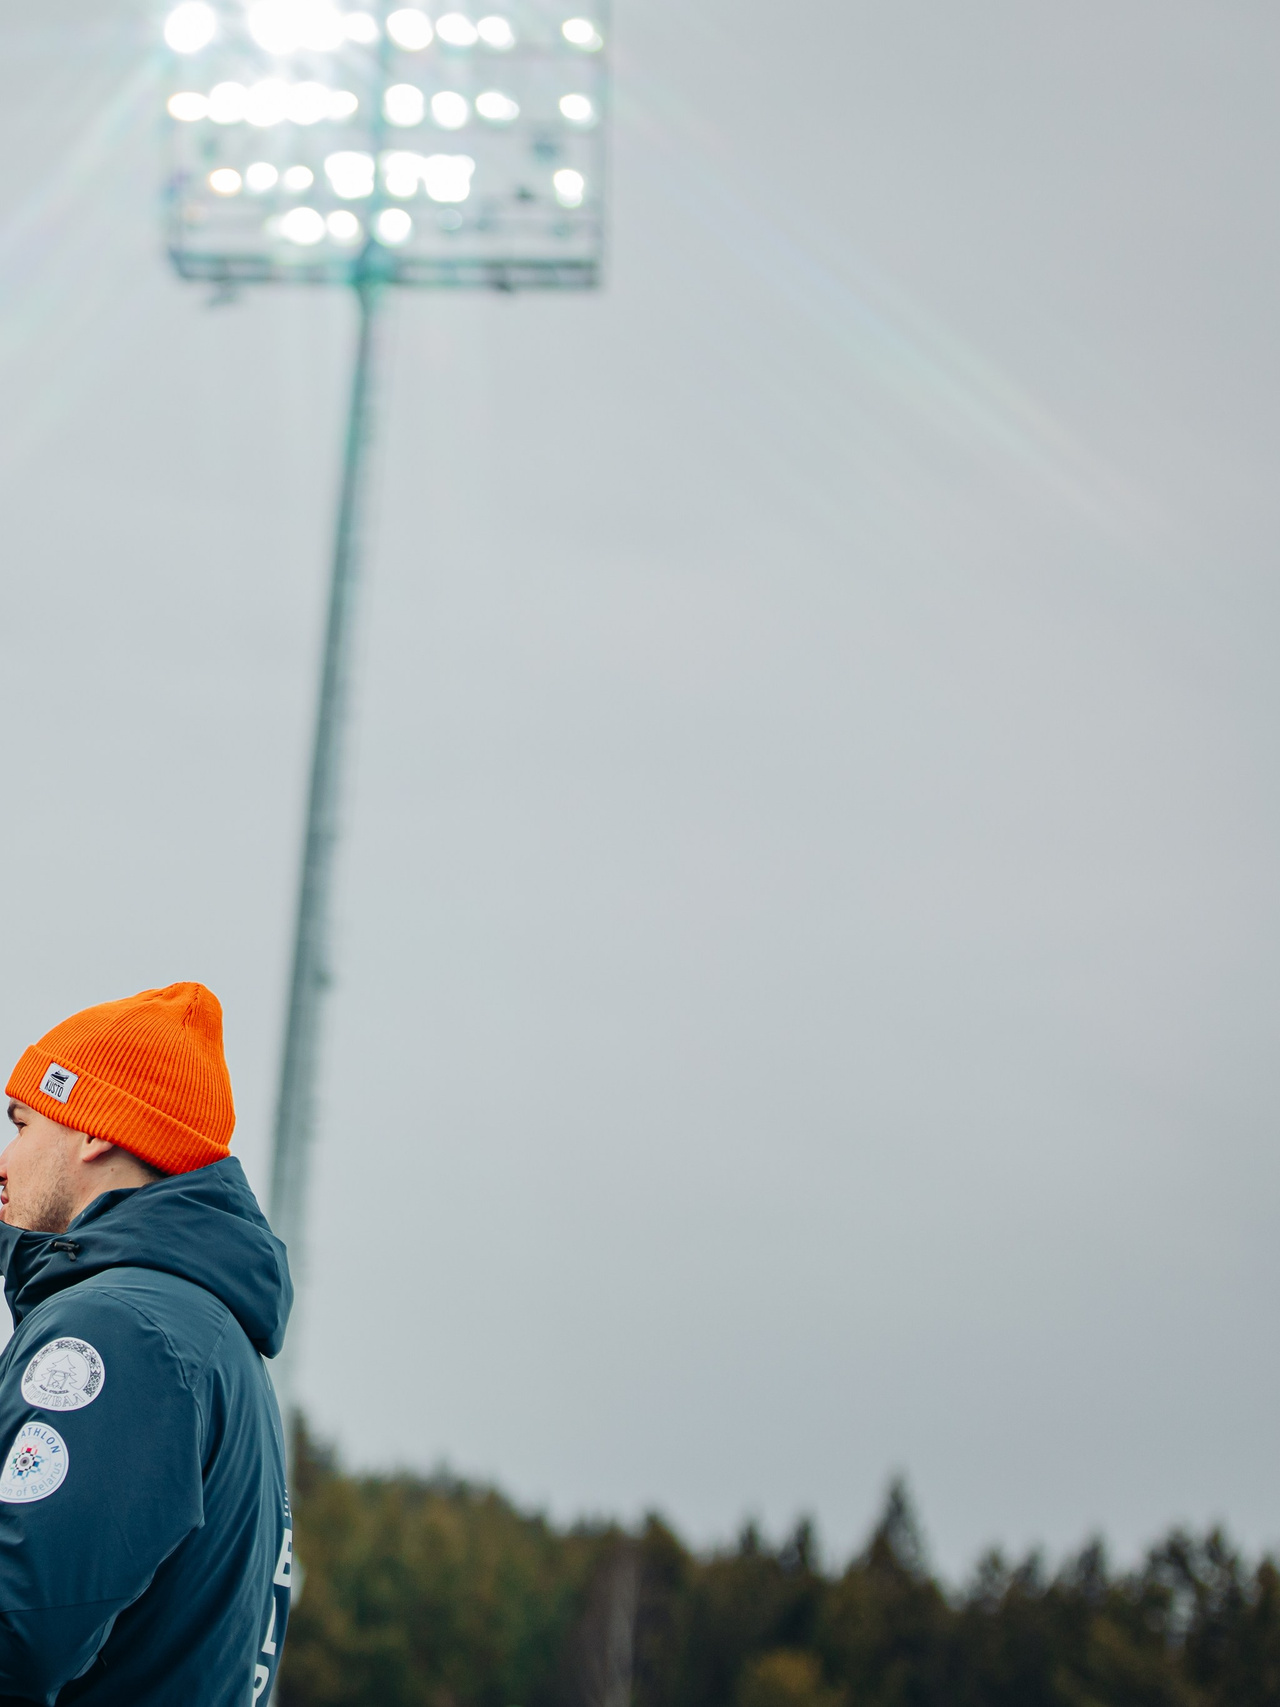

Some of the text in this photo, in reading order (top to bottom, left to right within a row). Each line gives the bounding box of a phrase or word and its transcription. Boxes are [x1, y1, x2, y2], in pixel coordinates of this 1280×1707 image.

[24, 1383, 86, 1408] ПРИВАЛ
[20, 1427, 61, 1454] ATHLON
[16, 1486, 27, 1497] of
[30, 1462, 62, 1495] Belarus
